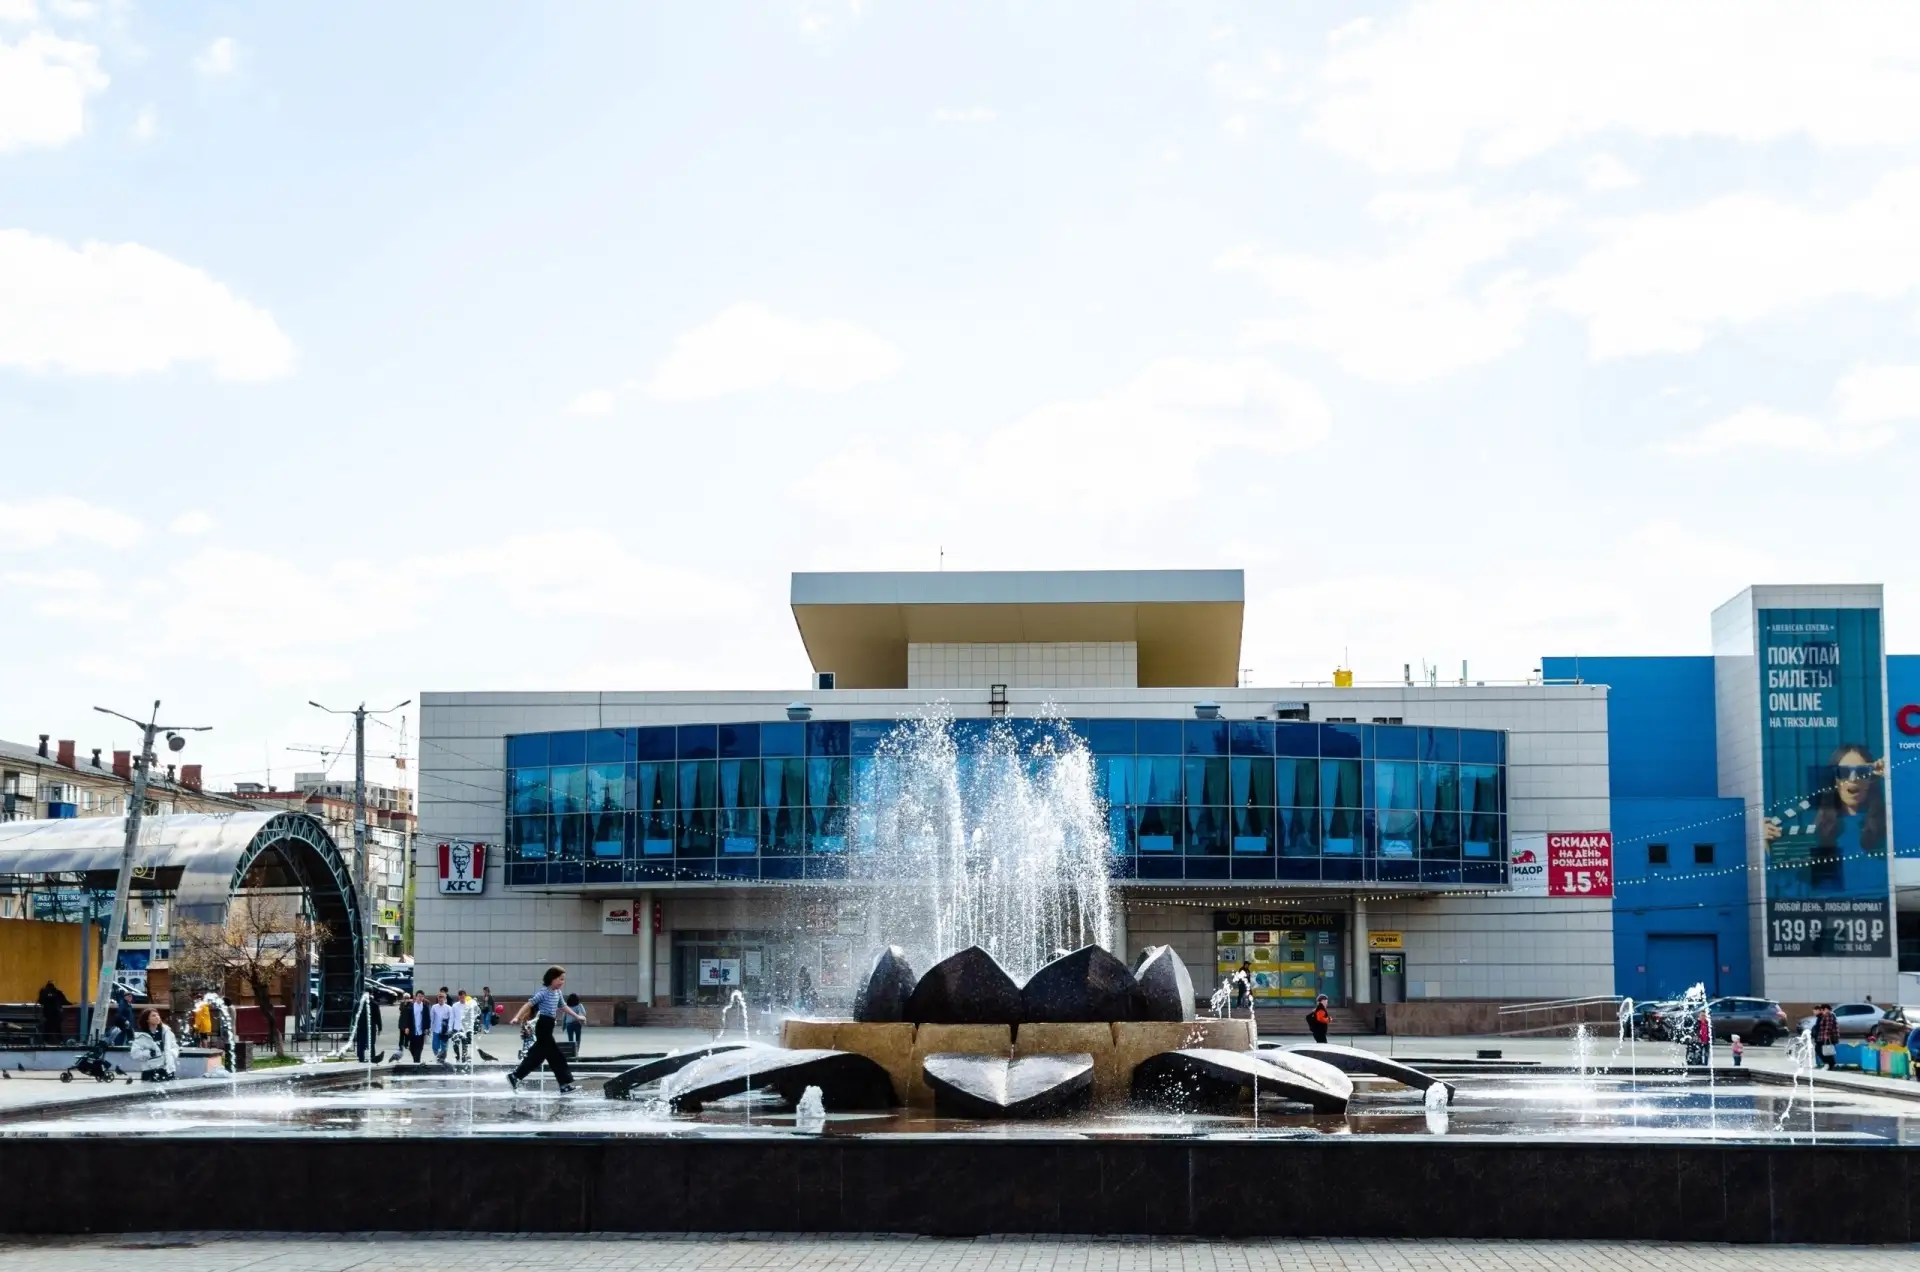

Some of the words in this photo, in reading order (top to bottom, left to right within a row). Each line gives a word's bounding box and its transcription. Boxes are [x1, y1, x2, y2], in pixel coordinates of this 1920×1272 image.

[1772, 624, 1803, 632] AMERICAN
[1805, 623, 1829, 632] CINEMA
[1768, 643, 1840, 665] ПОКУПАЙ
[1768, 669, 1833, 688] БИЛЕТЫ
[1769, 692, 1823, 711] ONLINE
[1769, 717, 1781, 728] НА
[1782, 716, 1838, 728] TRKSLAVA.RU
[1550, 836, 1609, 848] СКИДКА
[1559, 849, 1573, 858] НА
[1574, 849, 1602, 859] ДЕНЬ
[1552, 858, 1609, 868] РОЖДЕНИЯ
[1512, 865, 1543, 875] ИДОР
[446, 881, 476, 891] KFC
[1774, 901, 1800, 912] ЛЮБОЙ
[1824, 902, 1851, 912] ЛЮБОЙ
[1852, 902, 1883, 912] ФОРМАТ
[1243, 914, 1334, 926] ИНВЕСТБАНК
[1772, 919, 1806, 941] 139
[1833, 919, 1867, 941] 219
